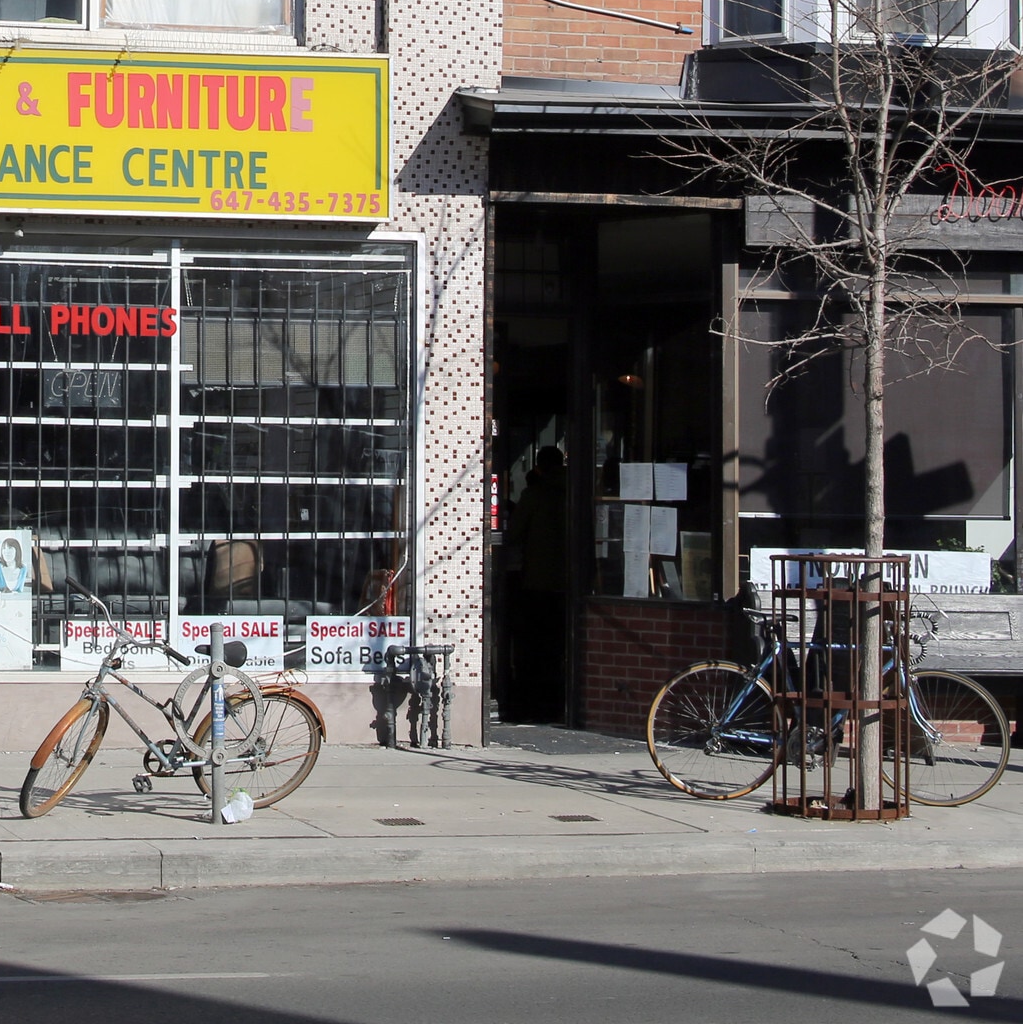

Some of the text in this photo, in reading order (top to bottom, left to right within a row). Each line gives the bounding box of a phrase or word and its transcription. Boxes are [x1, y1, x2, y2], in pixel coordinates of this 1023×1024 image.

[15, 81, 42, 117] &
[67, 71, 314, 133] FURNITURE
[121, 147, 268, 190] CENTRE
[210, 189, 381, 214] 647-435-7375
[51, 303, 177, 337] PHONES
[66, 622, 163, 642] Special SALE
[182, 622, 279, 642] Speal SALE
[310, 622, 406, 642] Special SALE
[82, 642, 154, 655] Bedoom
[311, 646, 352, 665] Sofa
